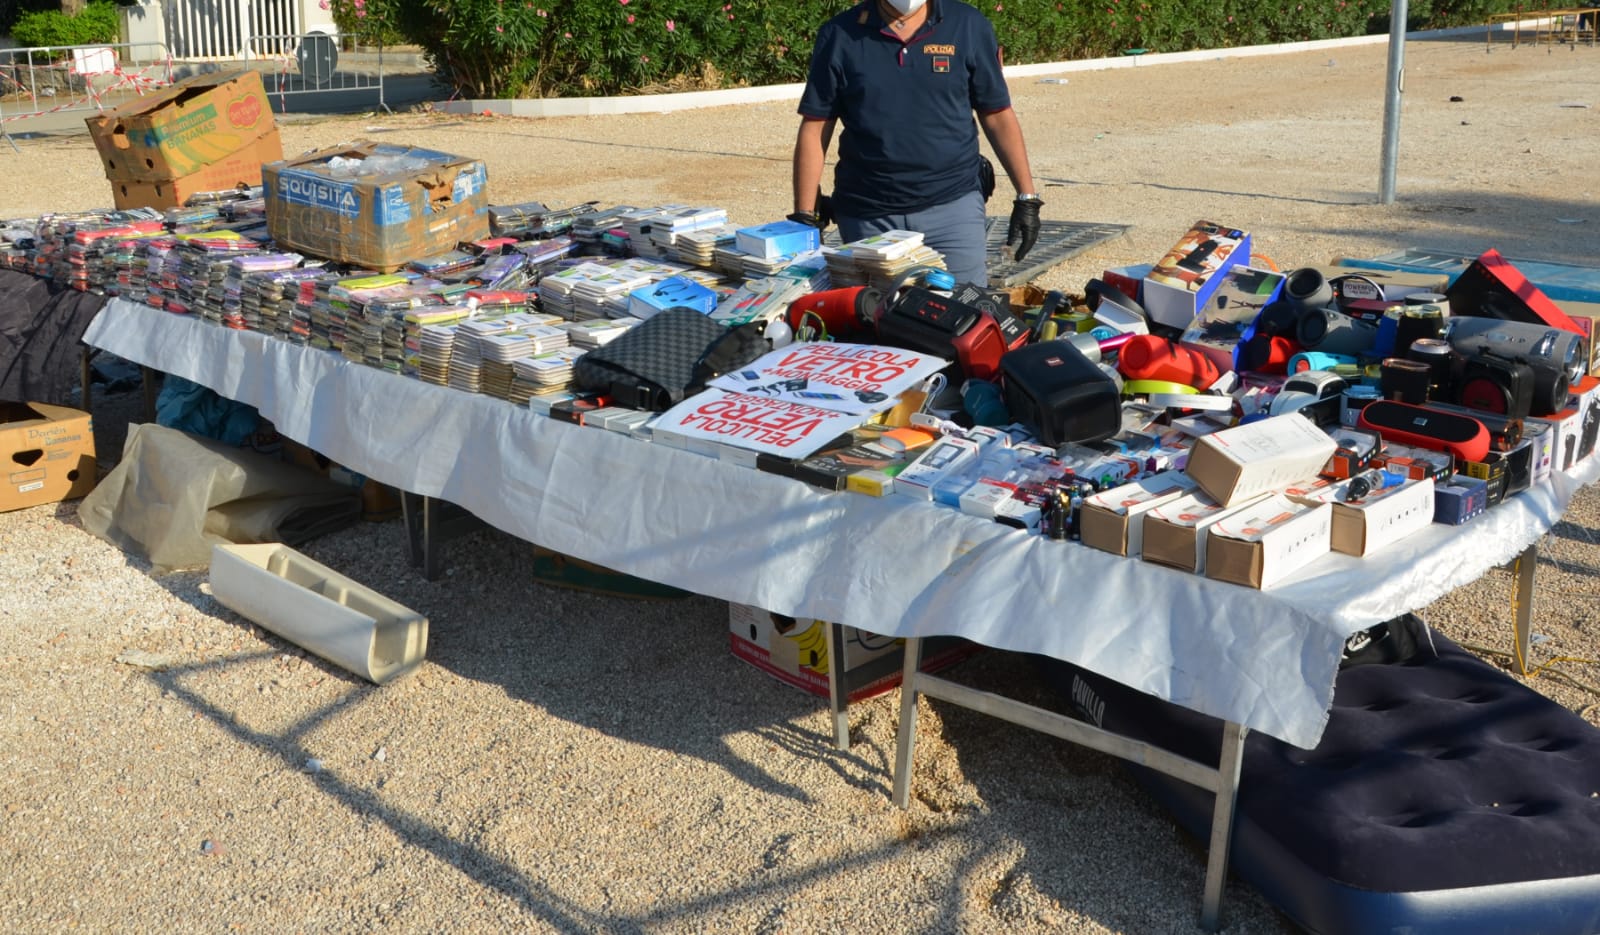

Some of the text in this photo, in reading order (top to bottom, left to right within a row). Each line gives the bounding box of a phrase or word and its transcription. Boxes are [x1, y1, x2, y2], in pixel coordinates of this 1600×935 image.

[167, 121, 217, 150] BANANAS
[278, 176, 356, 207] SQUISITA
[777, 352, 905, 383] VETRO
[797, 343, 921, 370] PELLICOLA
[762, 368, 882, 392] +MONTAGGIO
[697, 400, 825, 437] VETRO
[722, 392, 842, 419] +MONTAGGIO
[679, 413, 802, 448] PELLICOLA
[1072, 674, 1106, 729] PAVILLO
